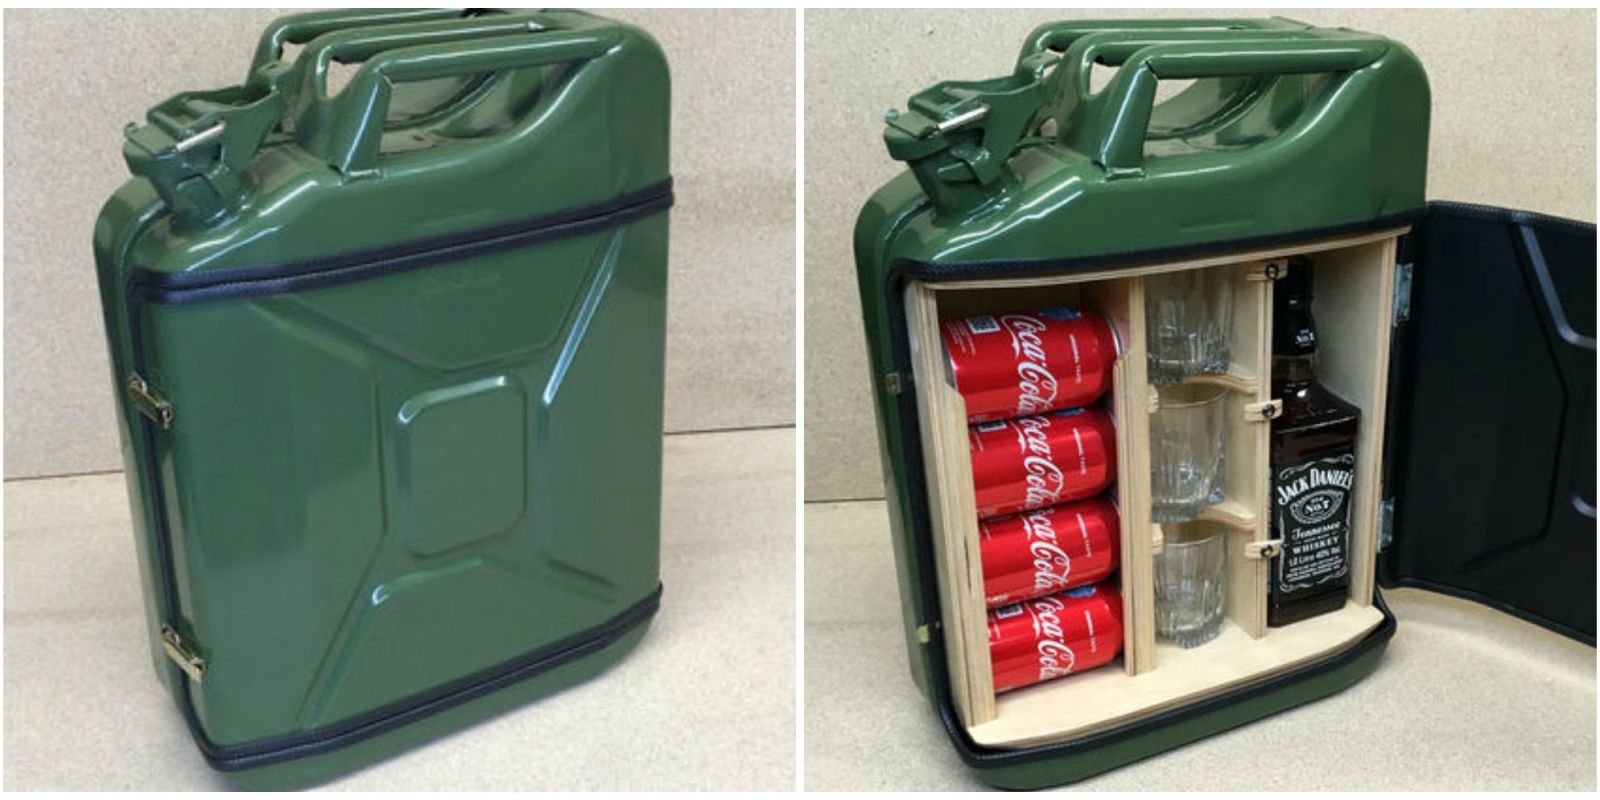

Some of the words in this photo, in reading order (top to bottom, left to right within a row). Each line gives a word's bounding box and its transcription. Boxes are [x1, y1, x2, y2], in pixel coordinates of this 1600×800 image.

[1001, 315, 1058, 415] Coca-Cola
[1277, 476, 1309, 505] JACK
[1293, 535, 1340, 554] WHISKEY
